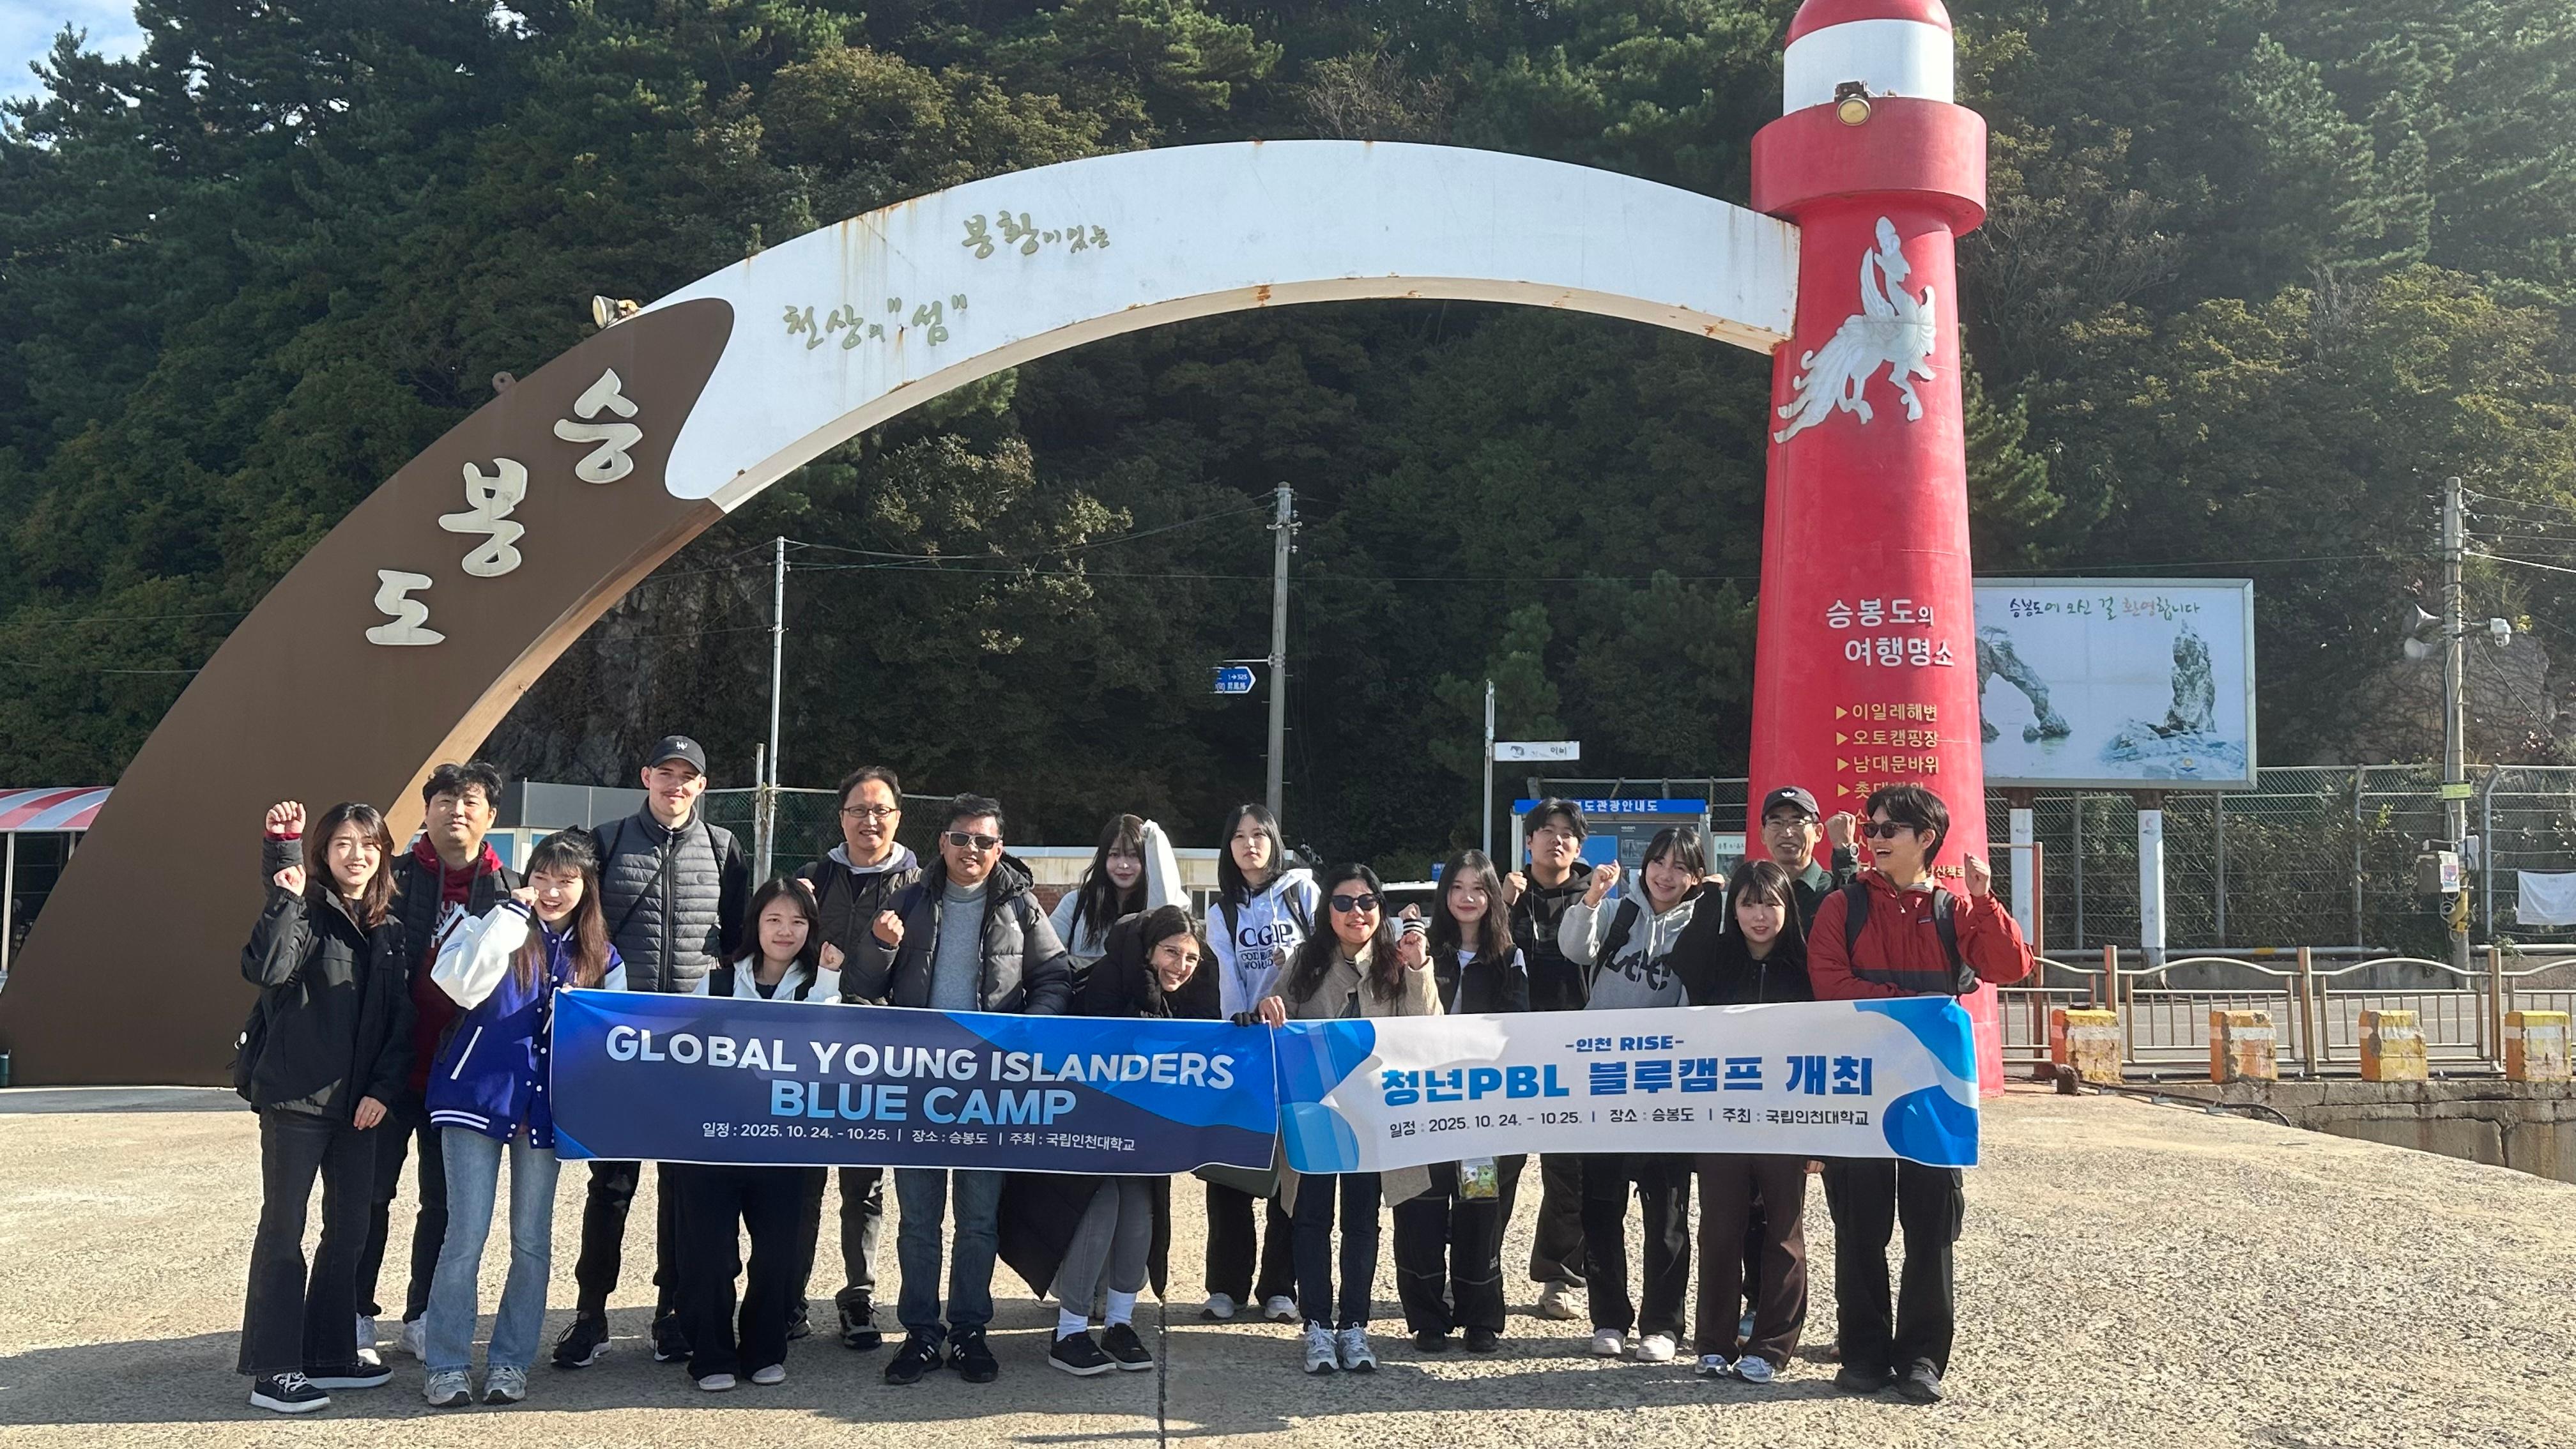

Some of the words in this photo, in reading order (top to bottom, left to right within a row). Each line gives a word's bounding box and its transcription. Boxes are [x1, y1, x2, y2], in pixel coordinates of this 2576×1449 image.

[783, 305, 885, 350] 천상의
[365, 368, 643, 646] 승봉도
[1826, 598, 1935, 629] 승봉도의
[2009, 597, 2060, 618] 승봉도에
[2067, 599, 2092, 615] 오신
[2122, 596, 2200, 620] 환영합니다
[1844, 638, 1955, 667] 여행명소
[1853, 703, 1938, 723] 이일레해변
[1853, 730, 1940, 749] 오토캠핑장
[1853, 755, 1940, 774] 남대문바위
[1573, 799, 1659, 813] 도관광안내도
[606, 1025, 797, 1073] GLOBAL
[809, 1041, 978, 1080] YOUNG
[990, 1050, 1235, 1090] ISLANDERS
[1381, 1064, 1569, 1107] 청년PBL
[1589, 1056, 1763, 1095] 블루캠프
[1786, 1055, 1873, 1095] 개최
[770, 1079, 908, 1121] BLUE
[923, 1085, 1077, 1125] CAMP
[703, 1123, 730, 1137] 일정
[740, 1123, 783, 1137] 2025.
[786, 1125, 807, 1138] 10.
[810, 1126, 833, 1138] 24.
[847, 1128, 890, 1140] 10.25.
[912, 1130, 939, 1144] 장소
[949, 1131, 988, 1145] 승봉도
[1009, 1133, 1035, 1146] 주최
[1046, 1133, 1135, 1151] 국립인천대학교
[1390, 1120, 1416, 1138] 일정
[1429, 1117, 1470, 1133] 2025.
[1475, 1115, 1494, 1128] 10.
[1499, 1114, 1522, 1126] 24.
[1540, 1112, 1583, 1124] 10.25.
[1610, 1108, 1638, 1123] 장소
[1652, 1108, 1695, 1123] 승봉도
[1722, 1108, 1751, 1123] 주최
[1765, 1109, 1869, 1125] 국립인천대학교
